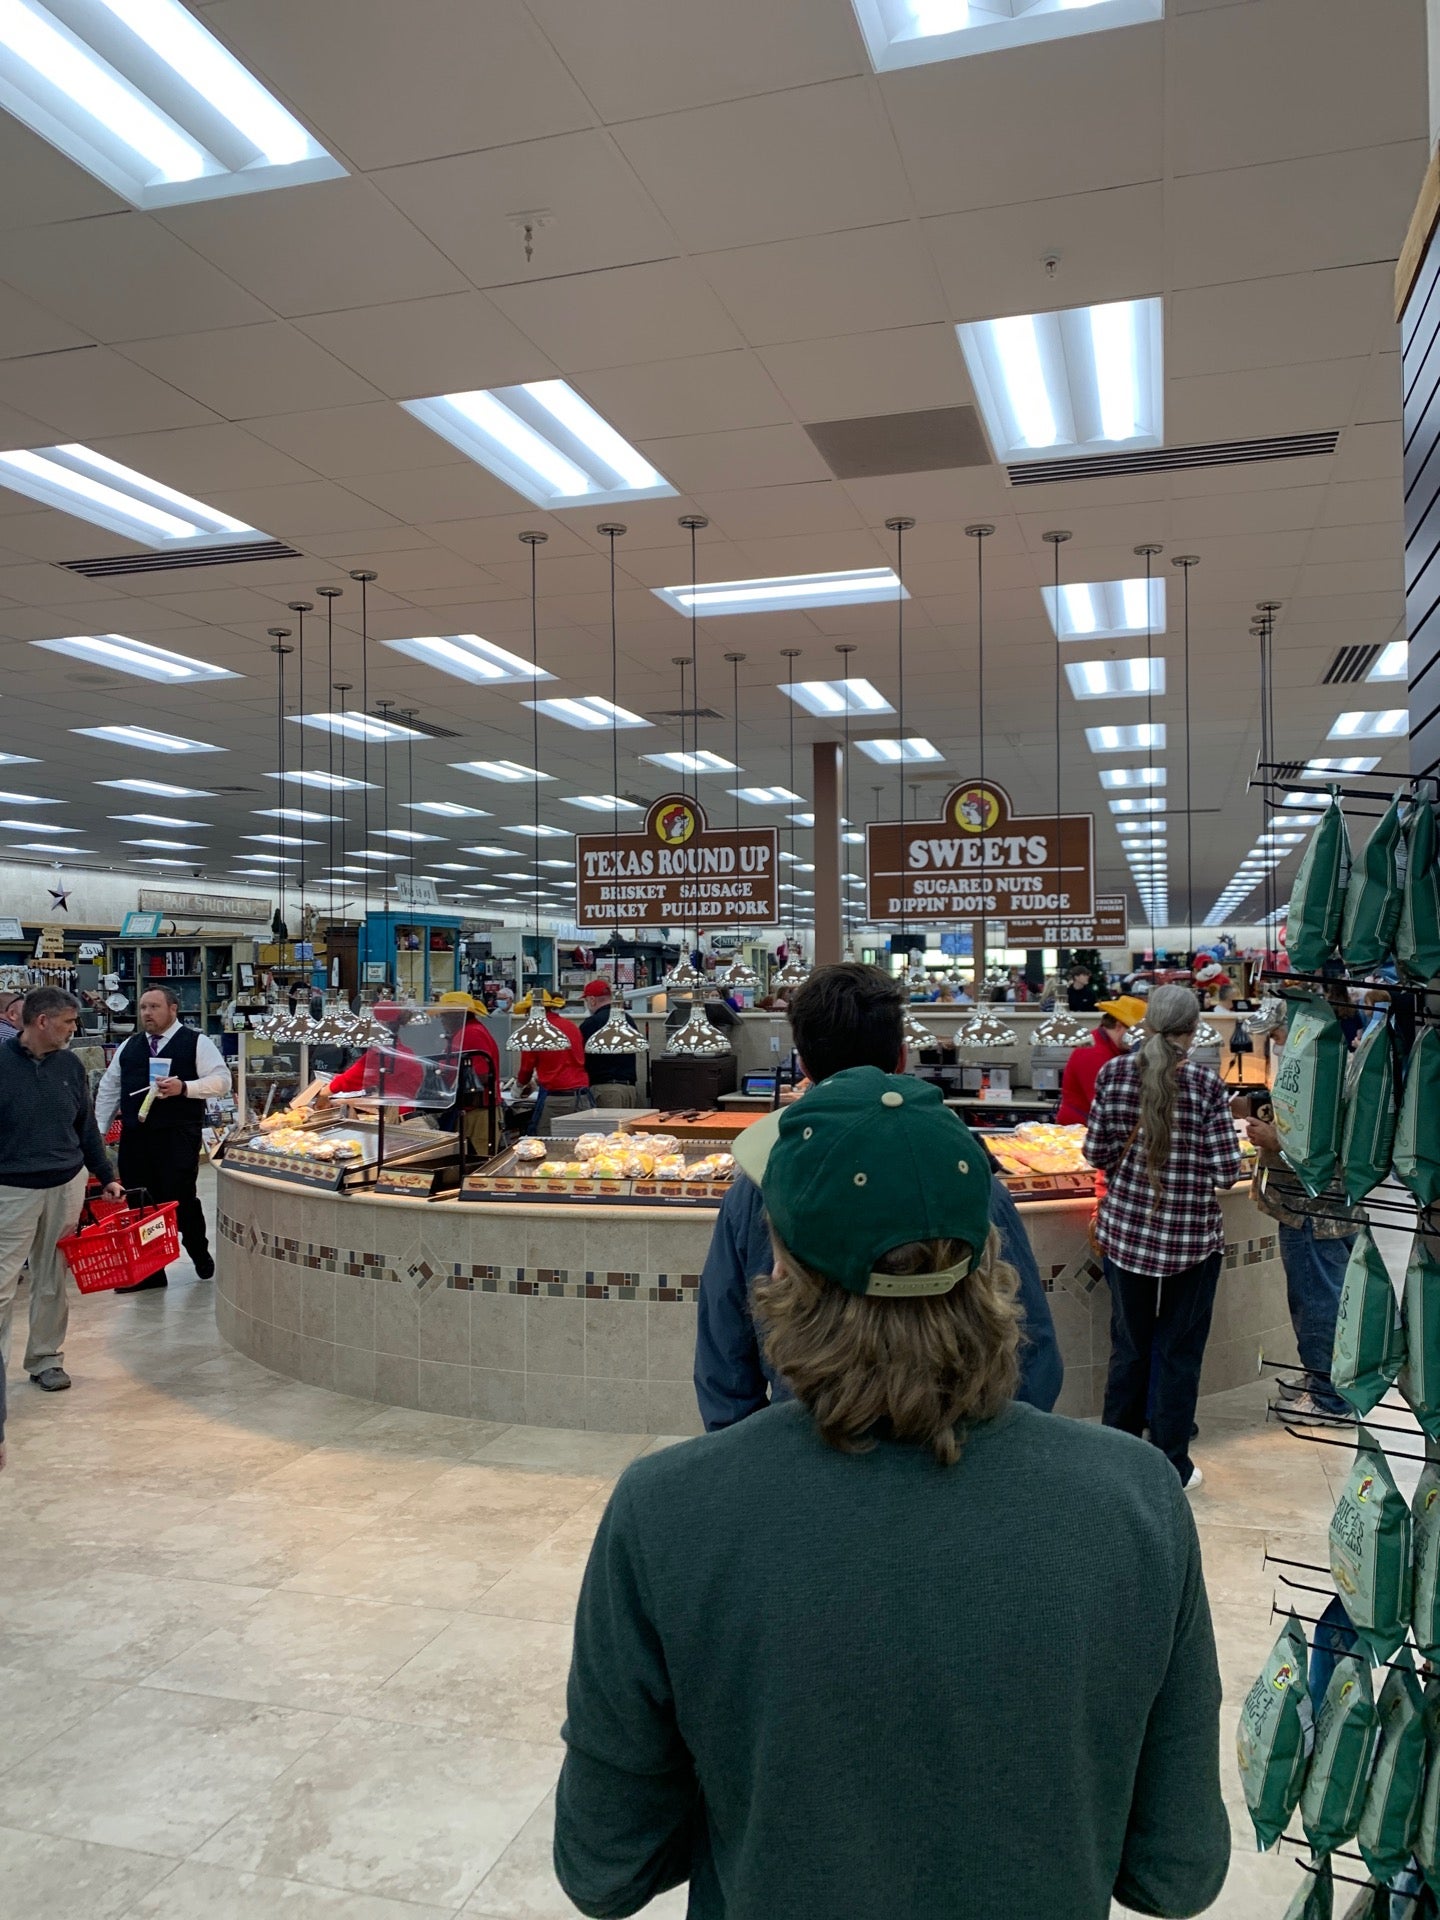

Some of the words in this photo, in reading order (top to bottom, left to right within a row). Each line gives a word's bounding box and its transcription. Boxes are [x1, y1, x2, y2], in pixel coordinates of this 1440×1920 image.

[584, 850, 654, 877] TEXAS
[658, 847, 736, 876] ROUND
[740, 845, 770, 872] UP
[908, 835, 1048, 869] SWEETS
[600, 884, 667, 900] BRISKET
[680, 882, 753, 898] SAUSAGE
[914, 878, 993, 895] SUGARED
[996, 877, 1043, 893] NUTS
[584, 903, 649, 918] TURKEY
[661, 901, 722, 917] PULLED
[725, 900, 770, 915] PORK
[889, 897, 949, 913] DIPPIN'
[952, 895, 997, 912] DOTS
[1011, 894, 1070, 910] FUDGE
[1044, 927, 1094, 942] HERE
